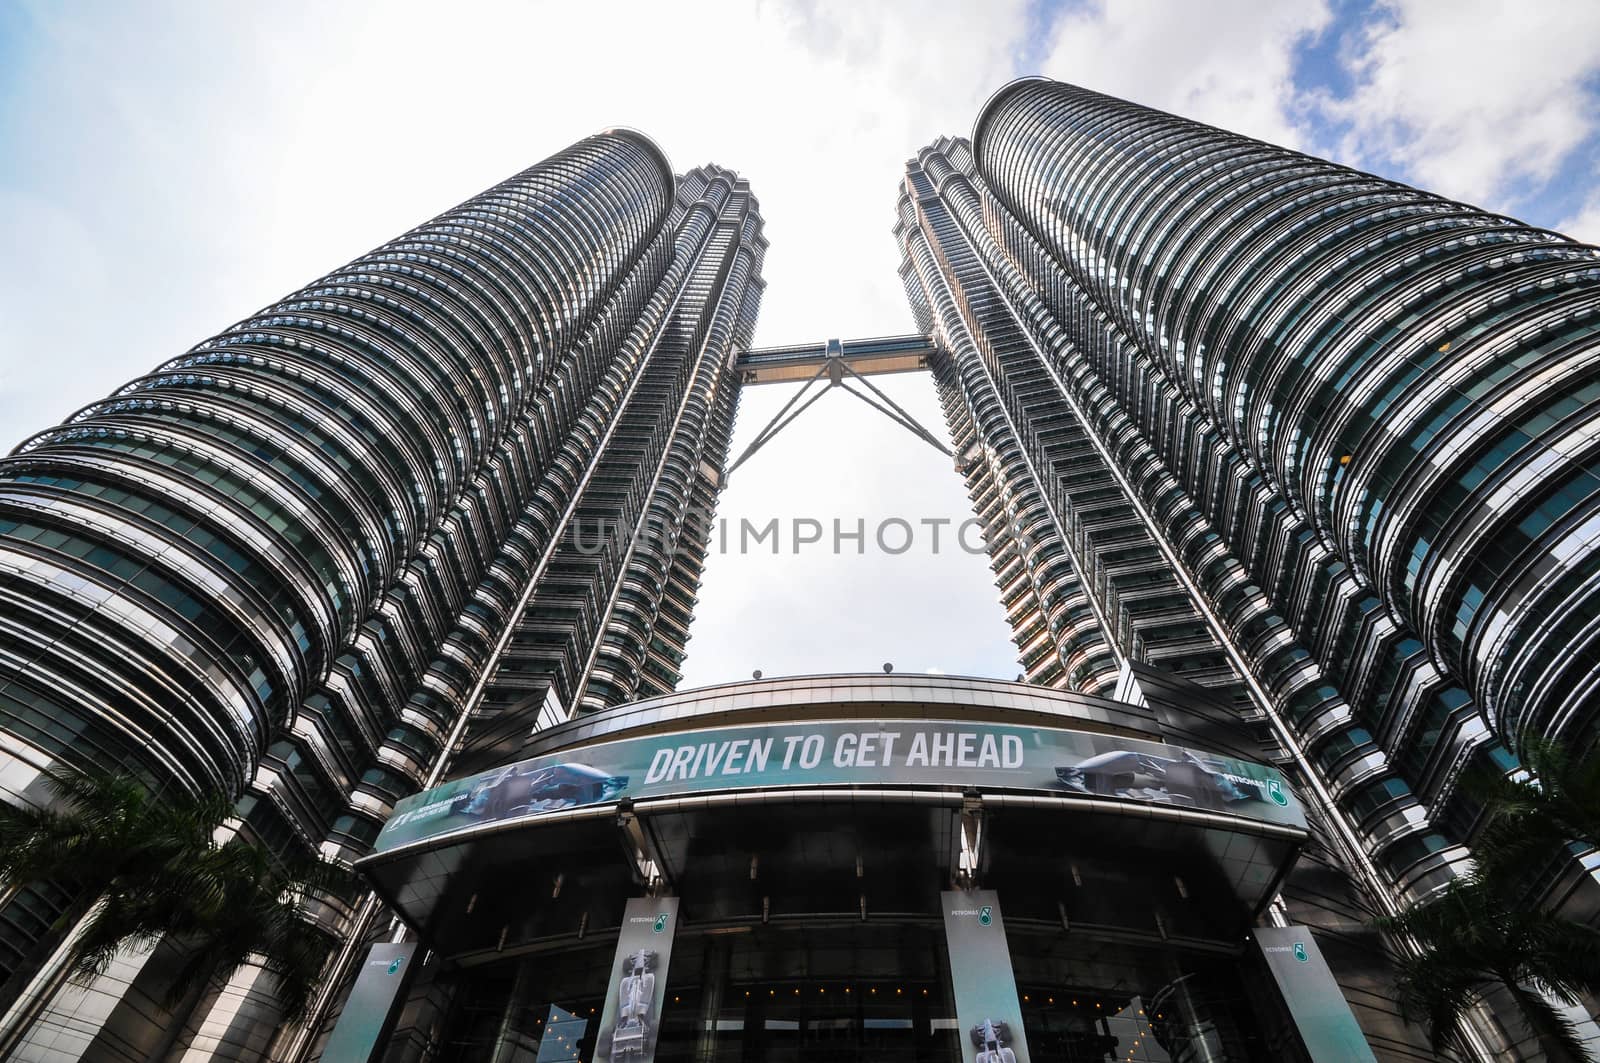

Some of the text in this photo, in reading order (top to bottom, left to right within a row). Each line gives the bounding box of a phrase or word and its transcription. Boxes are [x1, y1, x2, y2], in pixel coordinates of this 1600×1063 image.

[644, 731, 1024, 785] DRIVEN TO GET AHEAD
[1223, 773, 1265, 788] PETRONAS
